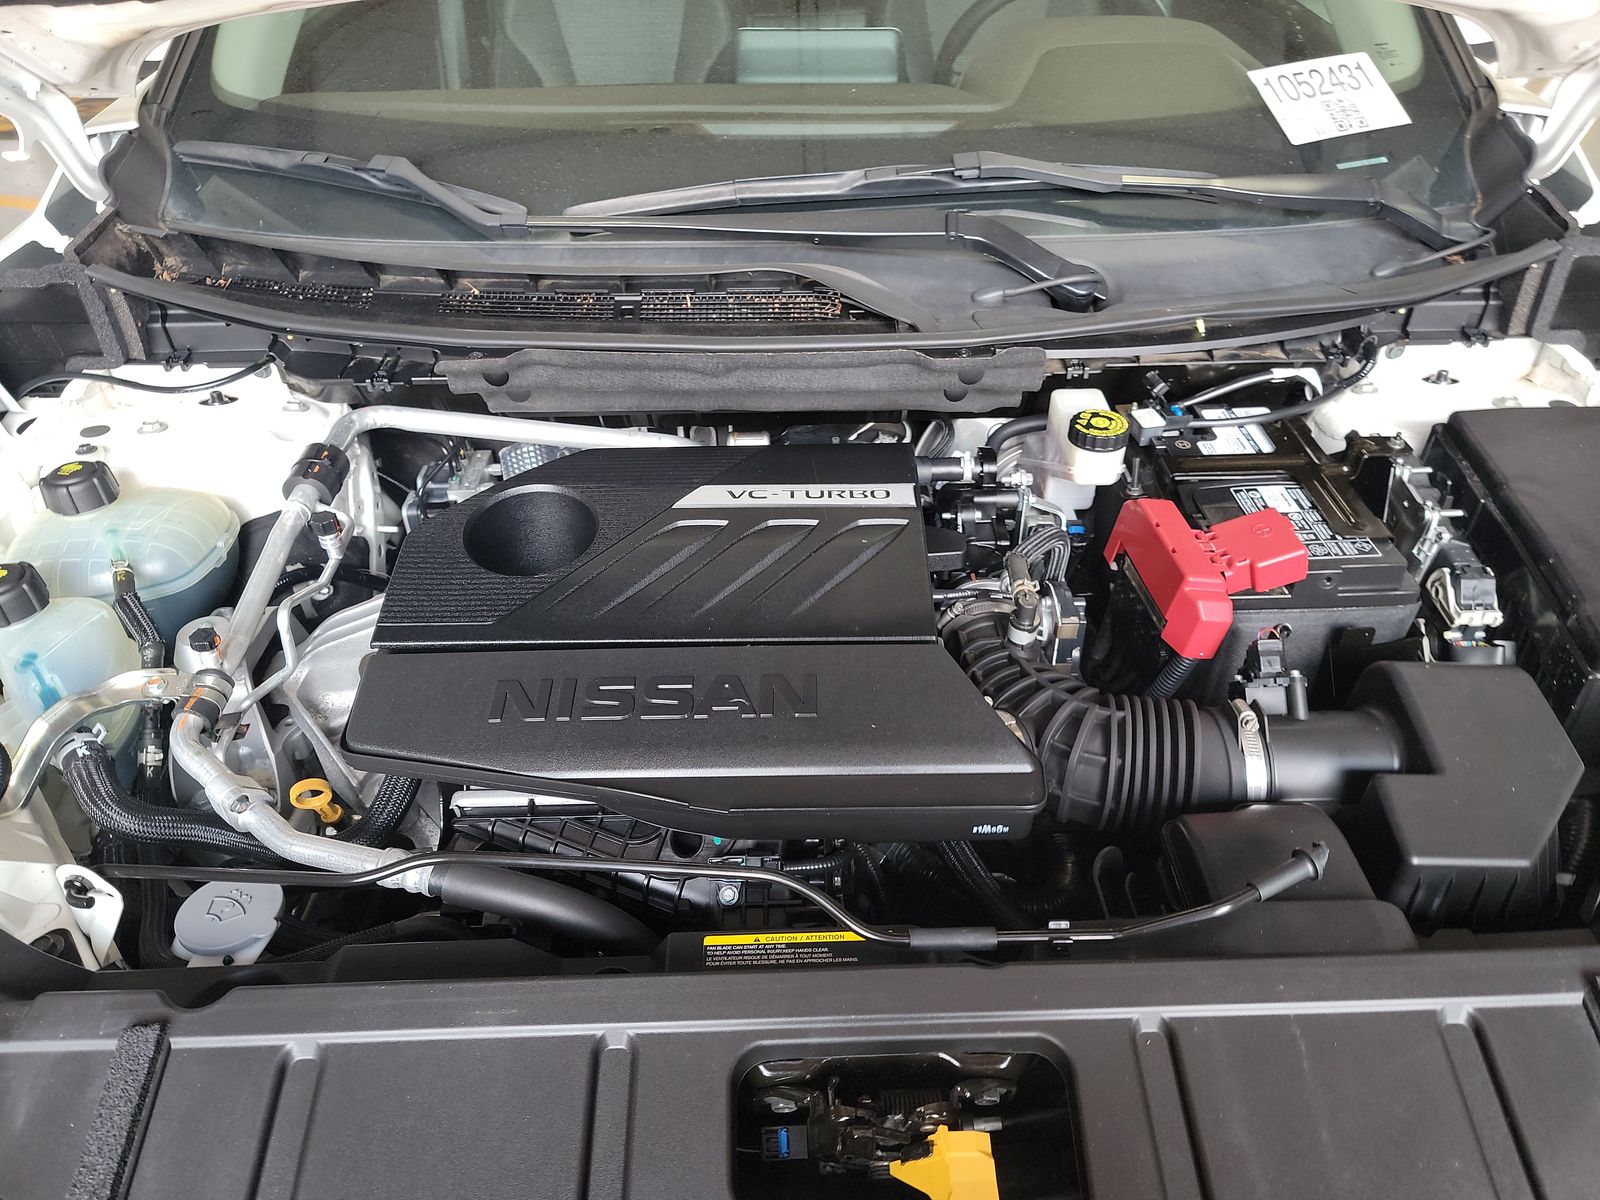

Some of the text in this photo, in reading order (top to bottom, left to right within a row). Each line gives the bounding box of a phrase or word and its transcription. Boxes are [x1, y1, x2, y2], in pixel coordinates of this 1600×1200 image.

[1263, 61, 1374, 104] 1052431
[726, 488, 891, 500] VC-TURBO
[487, 674, 818, 723] NISSAN
[146, 766, 154, 778] K
